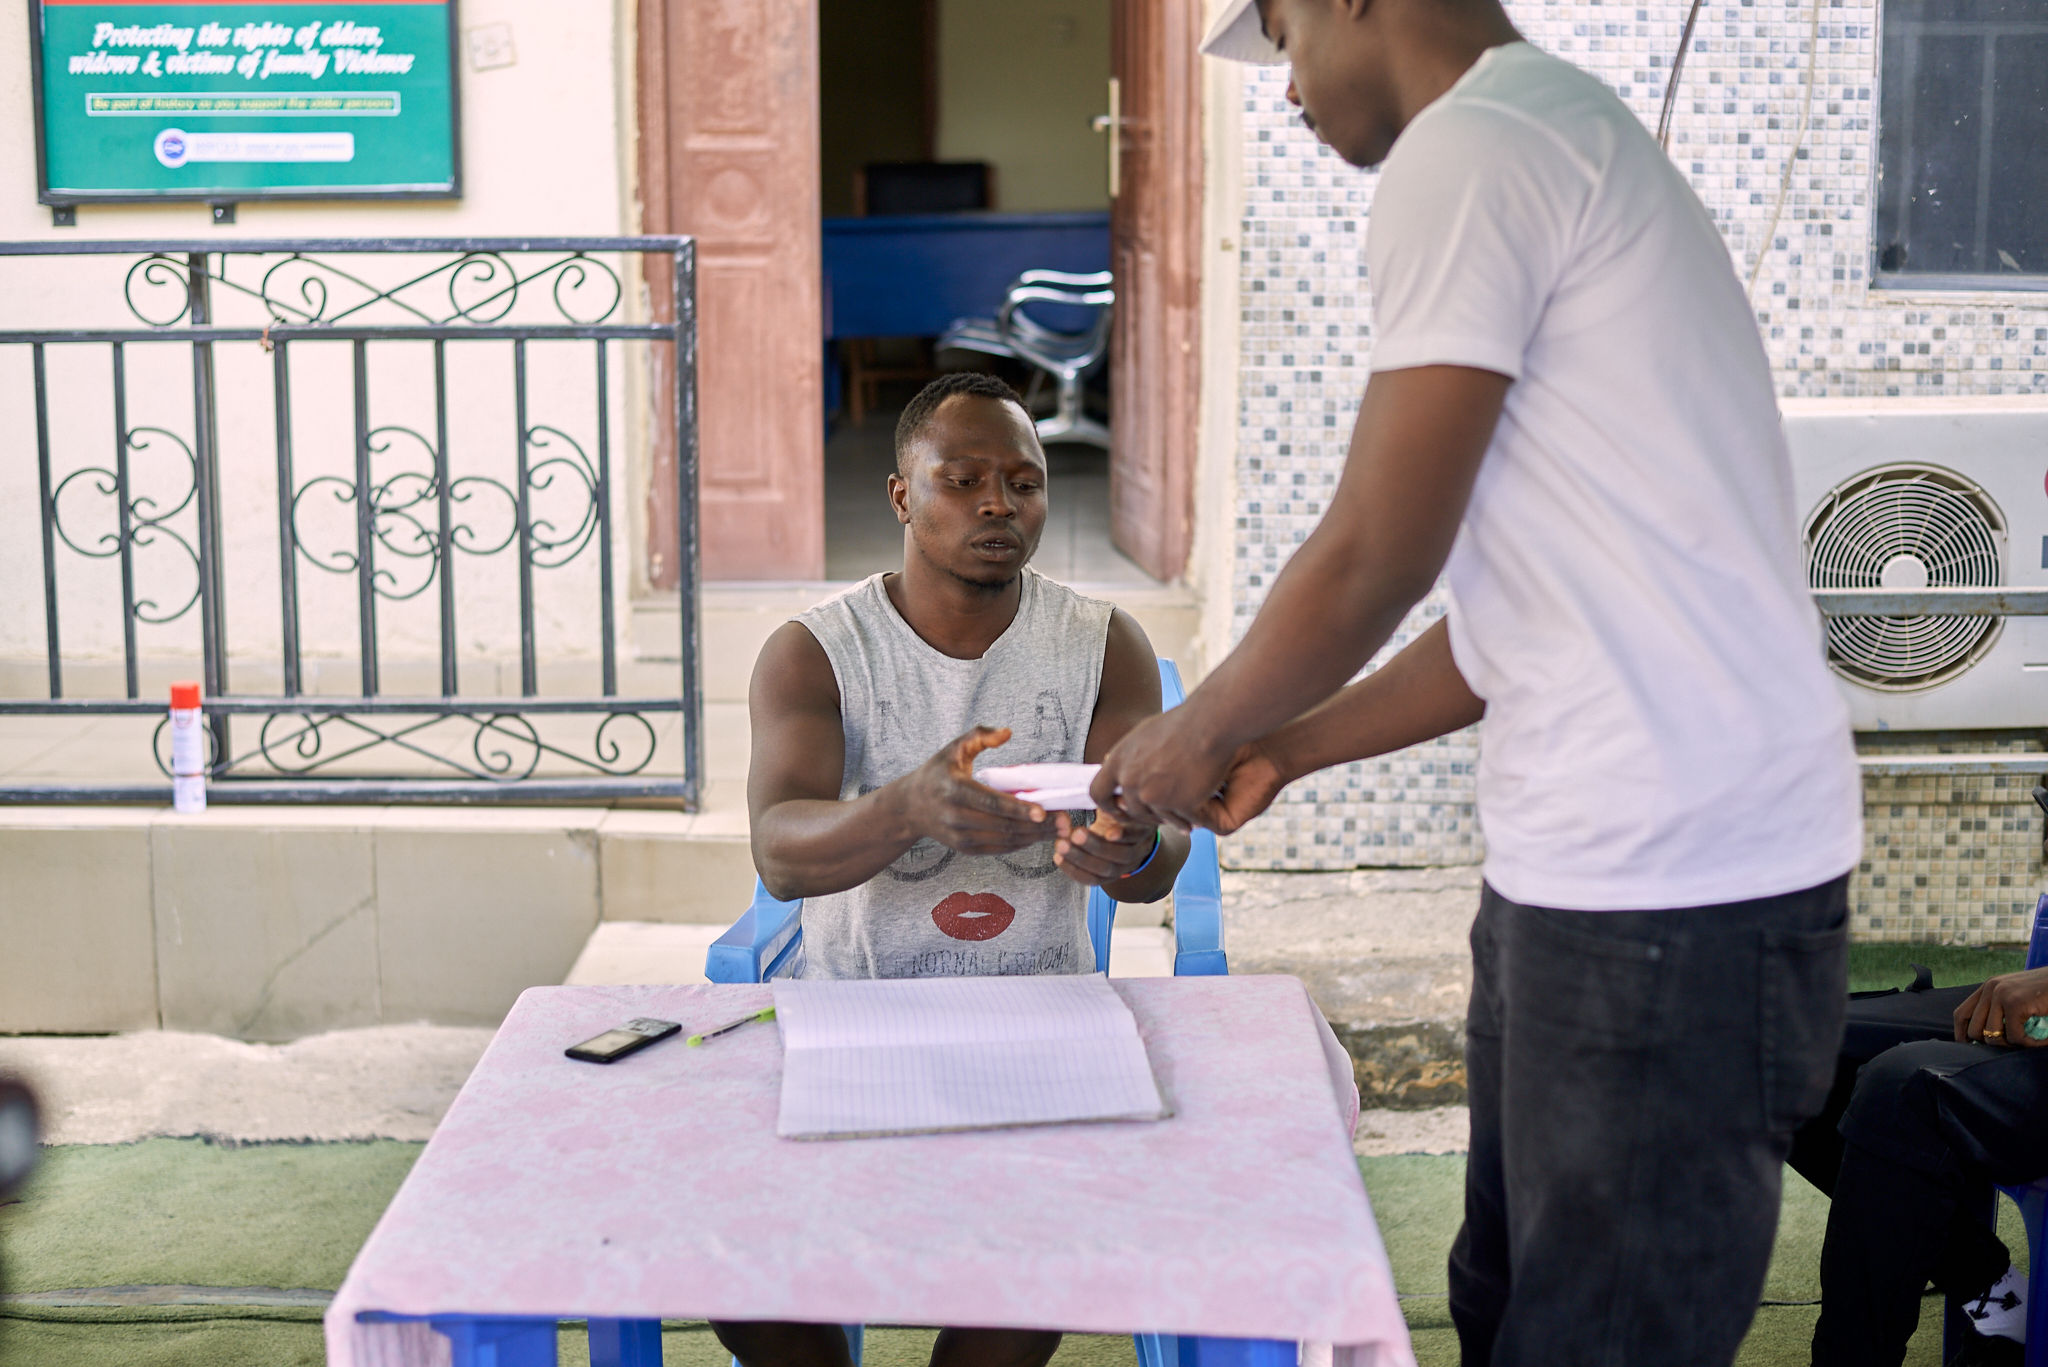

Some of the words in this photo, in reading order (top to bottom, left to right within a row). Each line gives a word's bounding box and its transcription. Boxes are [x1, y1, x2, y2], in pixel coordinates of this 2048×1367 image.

[92, 22, 195, 52] Protecting
[196, 22, 232, 47] the
[232, 21, 294, 52] rights
[294, 21, 322, 52] of
[68, 51, 141, 75] widows
[141, 51, 163, 77] &
[165, 51, 236, 75] victims
[236, 49, 264, 80] of
[259, 49, 331, 80] family
[333, 49, 415, 75] Violence
